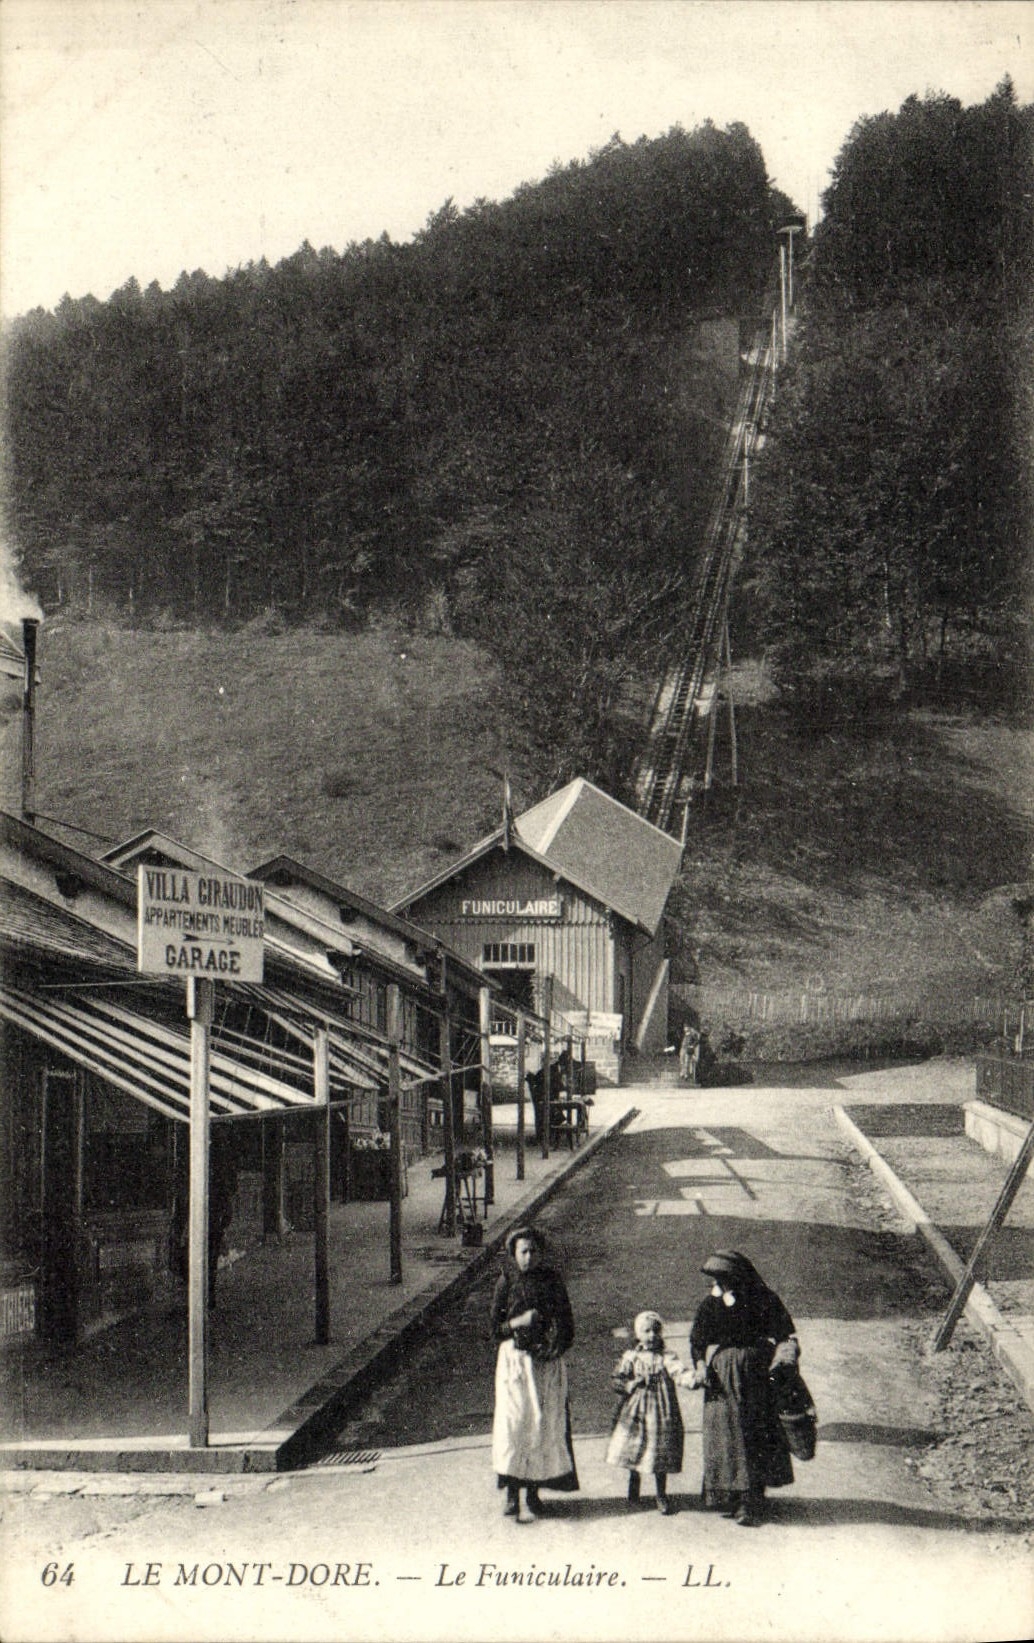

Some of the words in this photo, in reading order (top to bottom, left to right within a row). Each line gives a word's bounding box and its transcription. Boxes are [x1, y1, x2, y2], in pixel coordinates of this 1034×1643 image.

[146, 870, 190, 904] VILLA
[198, 877, 264, 913] GIRAUDON
[145, 906, 219, 933] APPARTEMENTS
[462, 899, 558, 915] FUNICULAIRE
[165, 944, 241, 974] GARAGE
